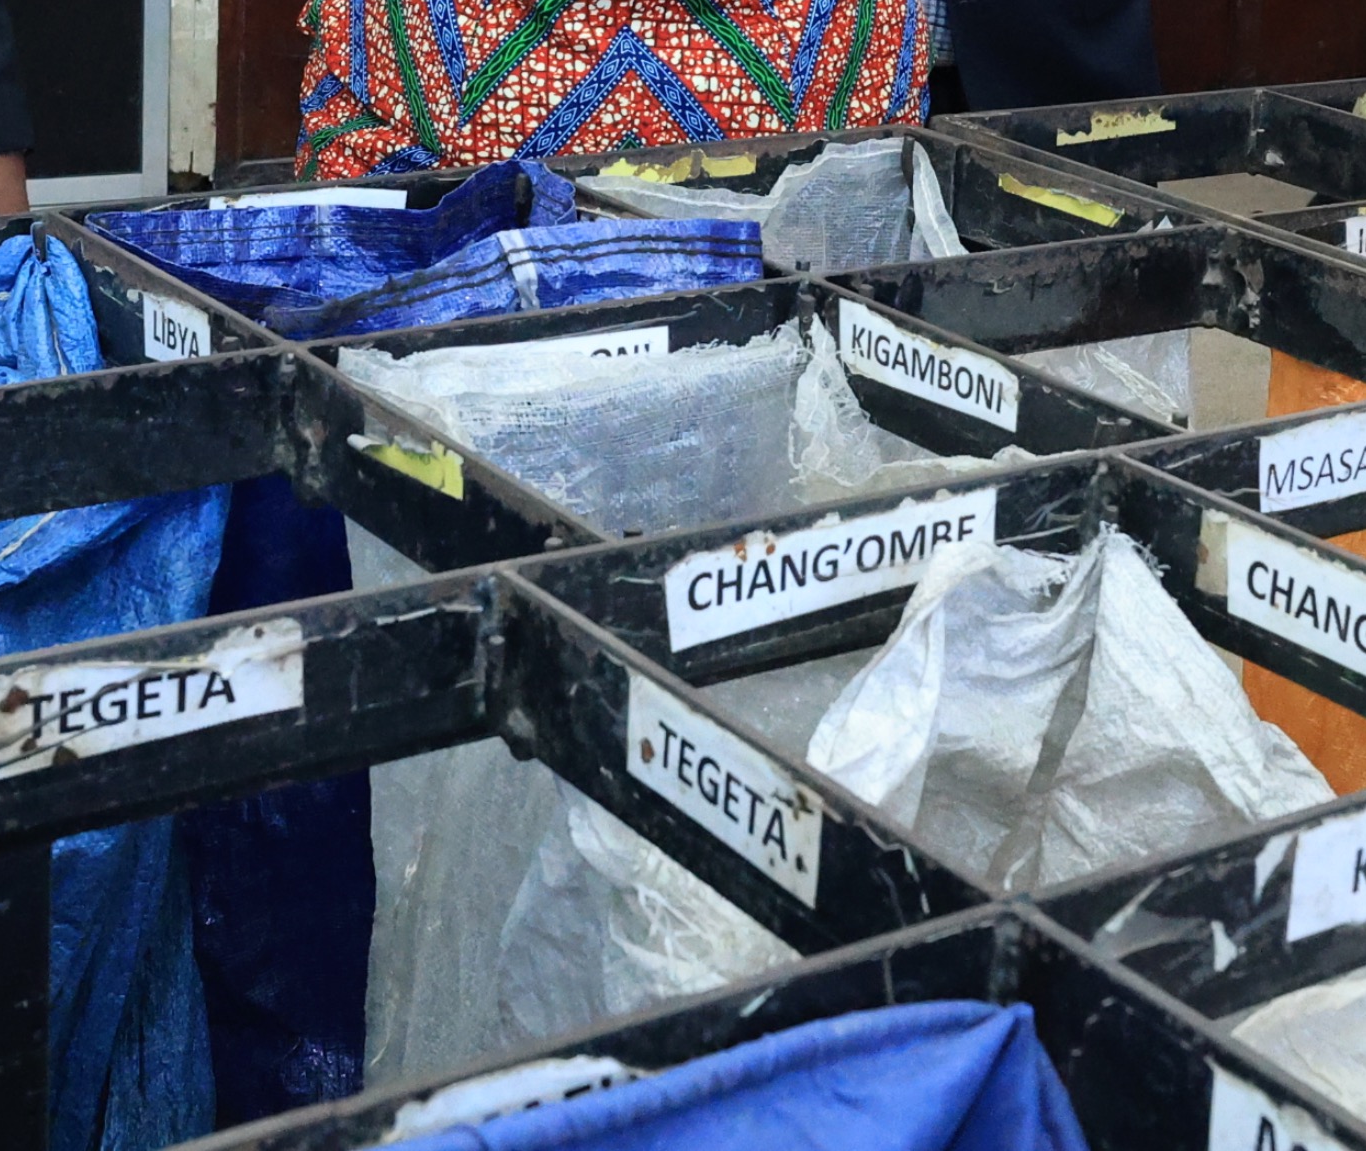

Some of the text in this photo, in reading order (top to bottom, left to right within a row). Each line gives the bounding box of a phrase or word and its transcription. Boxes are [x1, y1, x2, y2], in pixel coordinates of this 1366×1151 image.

[153, 309, 200, 358] LIBYA
[851, 323, 1005, 415] KIGAMBONI
[28, 668, 236, 740] TEGETA
[658, 719, 788, 862] TEGETA
